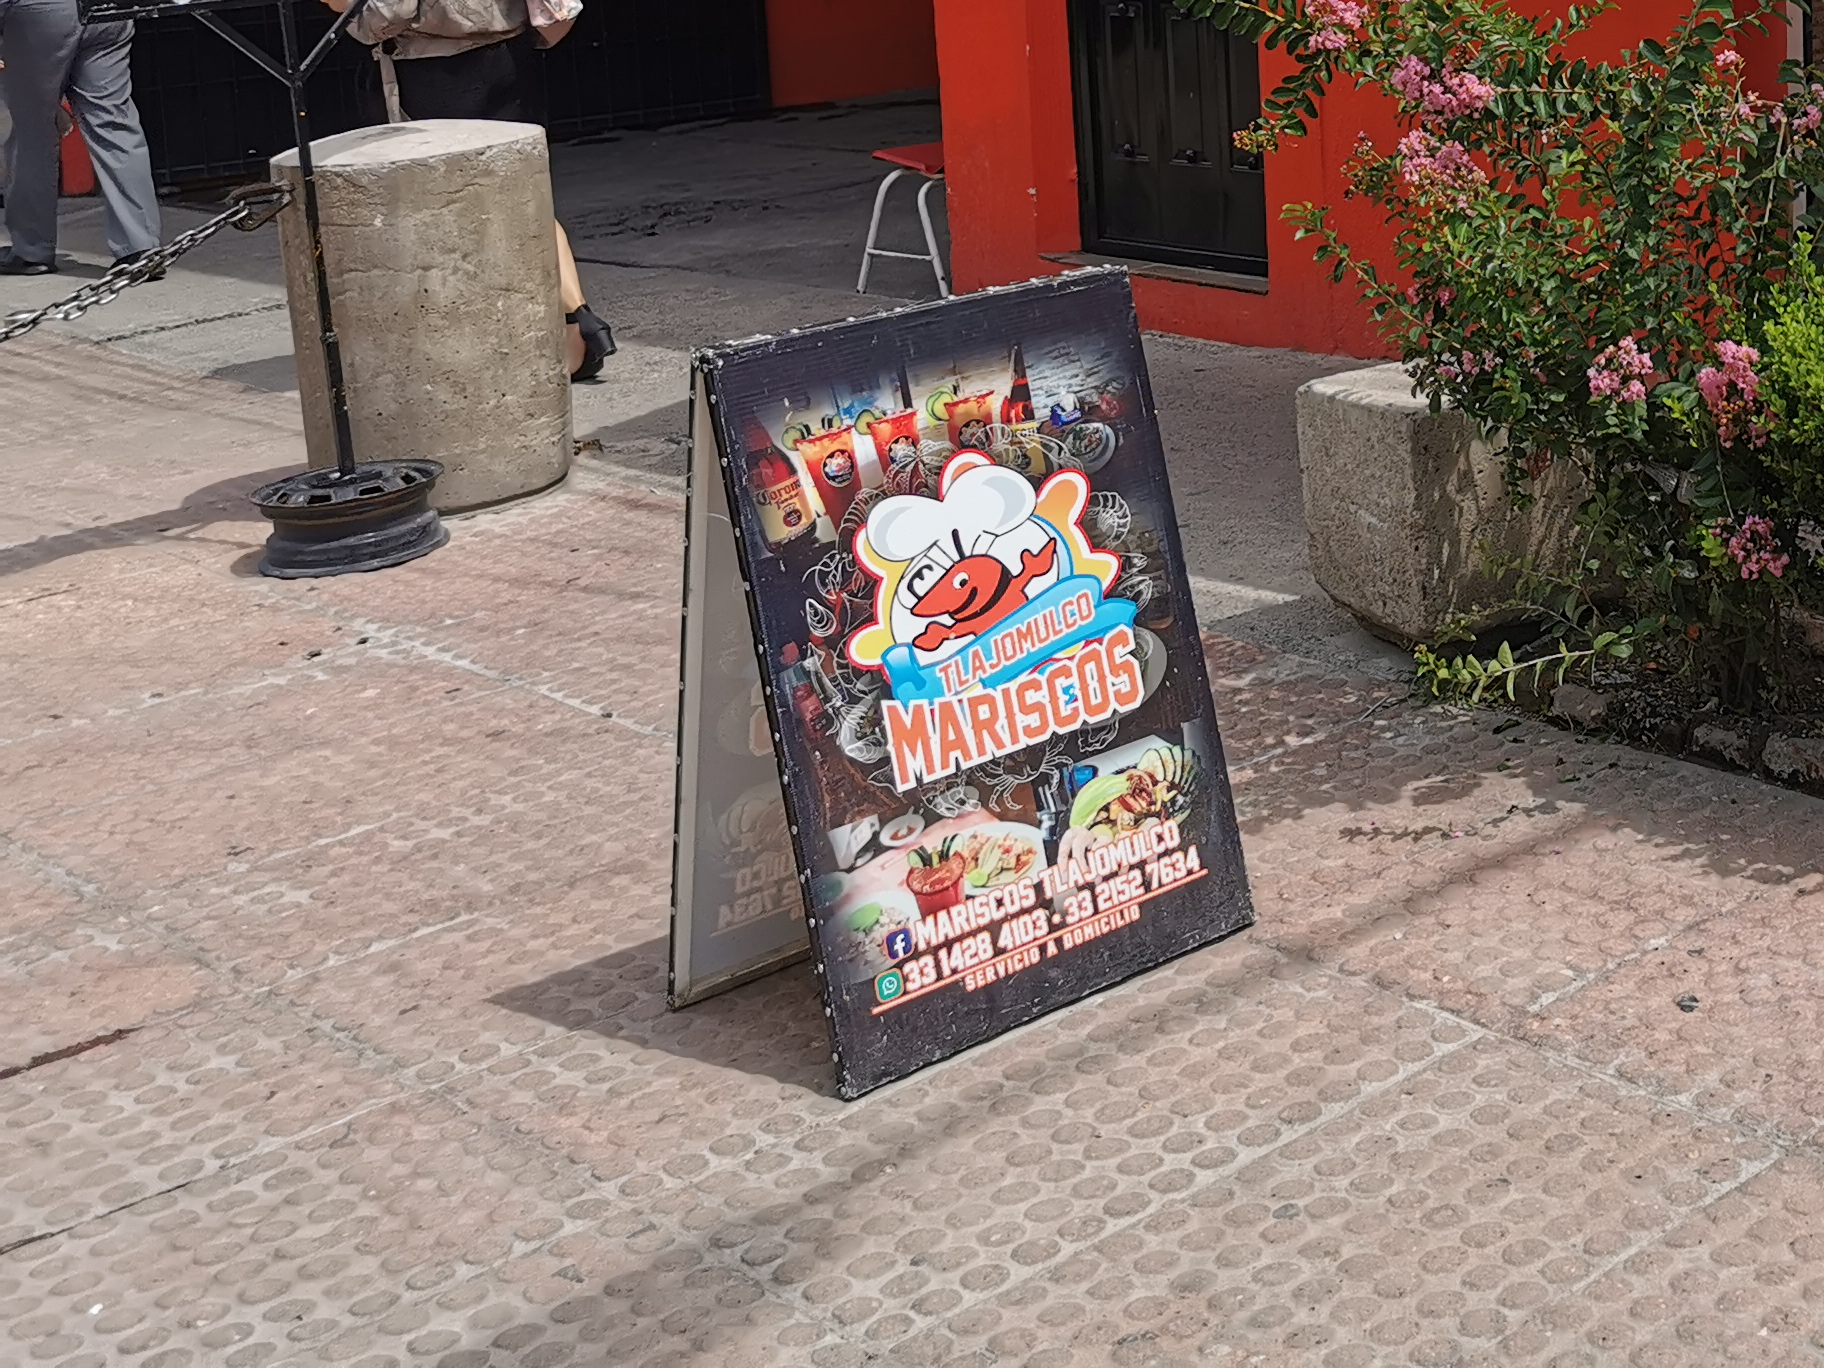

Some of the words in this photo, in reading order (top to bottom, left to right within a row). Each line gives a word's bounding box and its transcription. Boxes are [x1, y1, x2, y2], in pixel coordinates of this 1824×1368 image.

[881, 623, 1146, 793] MARISCOS
[935, 589, 1095, 696] TLAJOMULCO
[901, 953, 938, 993] 33
[937, 930, 995, 978] 1428
[996, 906, 1051, 952] 4103
[1062, 888, 1095, 927] 33
[1094, 867, 1147, 913] 2152
[1144, 844, 1201, 892] 7634
[914, 878, 1037, 953] MARISCOS
[1037, 817, 1182, 901] TLAJOMULCO
[963, 945, 1042, 994] SERVICIO
[1045, 937, 1060, 959] A
[1061, 903, 1142, 952] DOMICILIO
